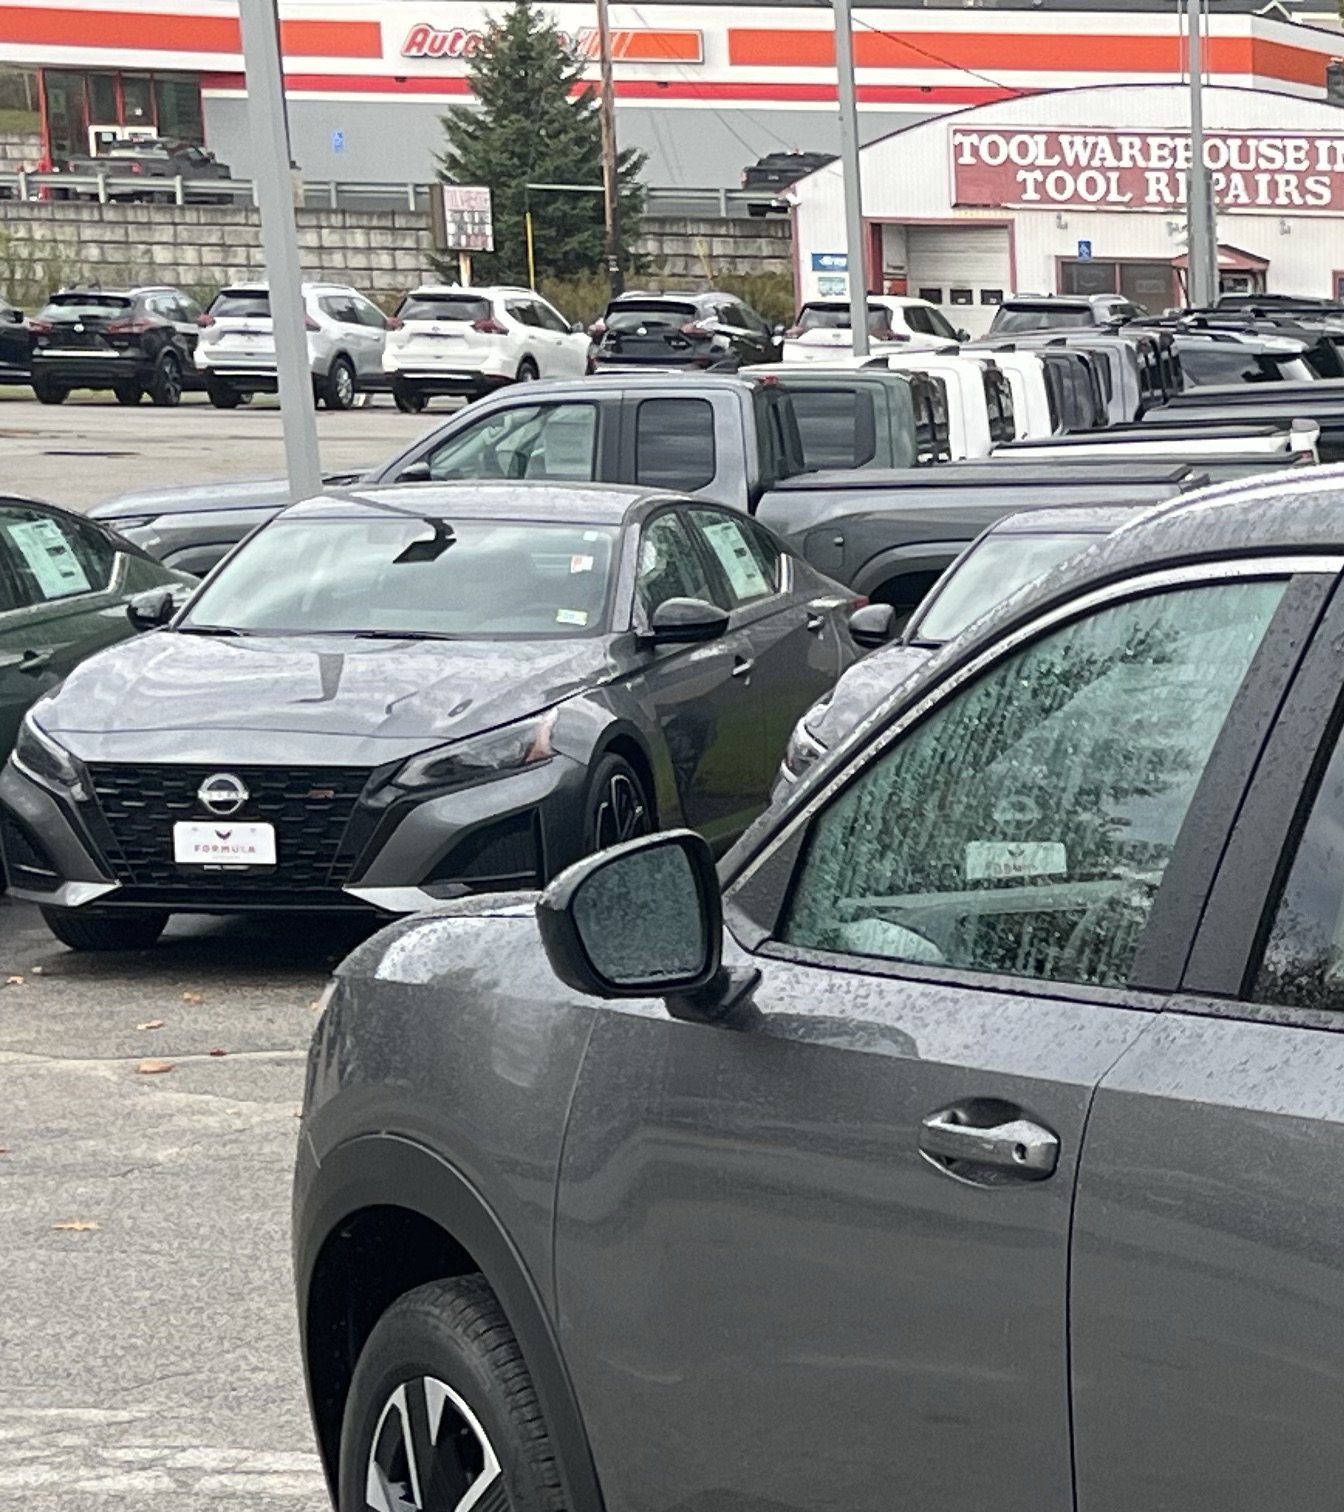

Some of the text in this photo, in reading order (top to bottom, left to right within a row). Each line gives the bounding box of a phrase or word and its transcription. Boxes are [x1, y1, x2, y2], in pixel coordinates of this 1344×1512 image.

[954, 132, 1060, 166] TOOL
[1058, 135, 1310, 172] WAREHOUSE
[1016, 169, 1133, 203] TOOL
[194, 844, 256, 854] FORMULA
